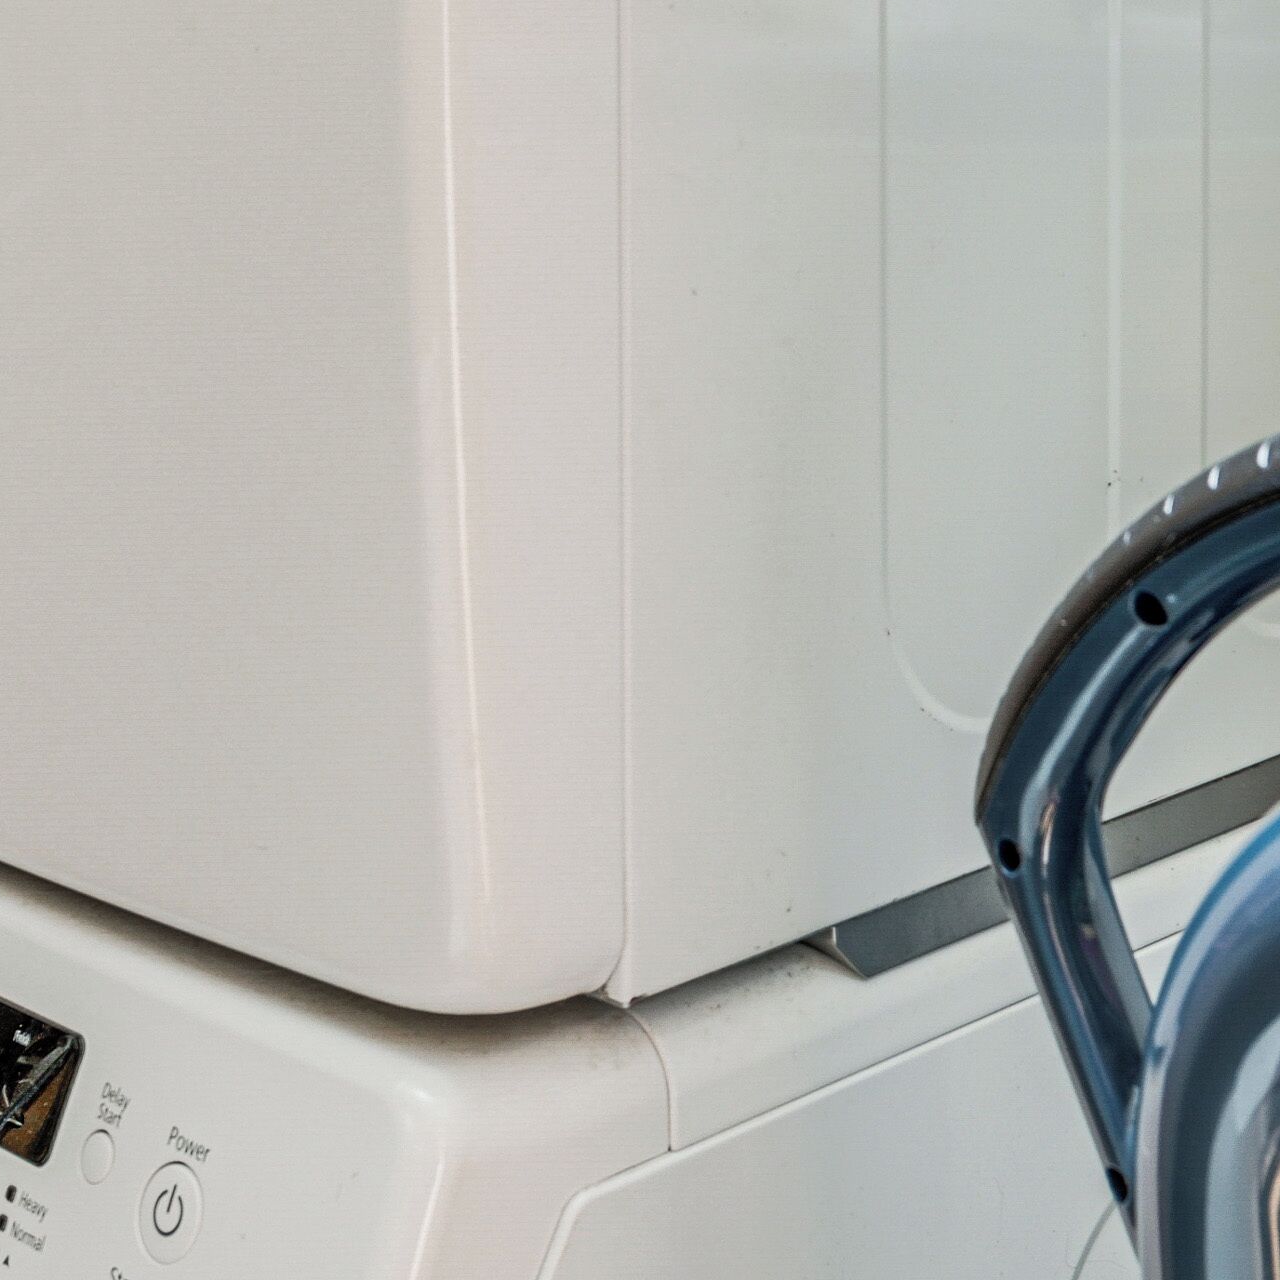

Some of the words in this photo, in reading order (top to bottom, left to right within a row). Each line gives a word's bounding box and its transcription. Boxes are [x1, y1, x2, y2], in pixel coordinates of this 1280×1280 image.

[101, 1082, 131, 1112] Delay
[97, 1103, 123, 1127] Start
[167, 1126, 211, 1163] Power
[18, 1191, 48, 1223] Heavy
[10, 1221, 47, 1252] Normal
